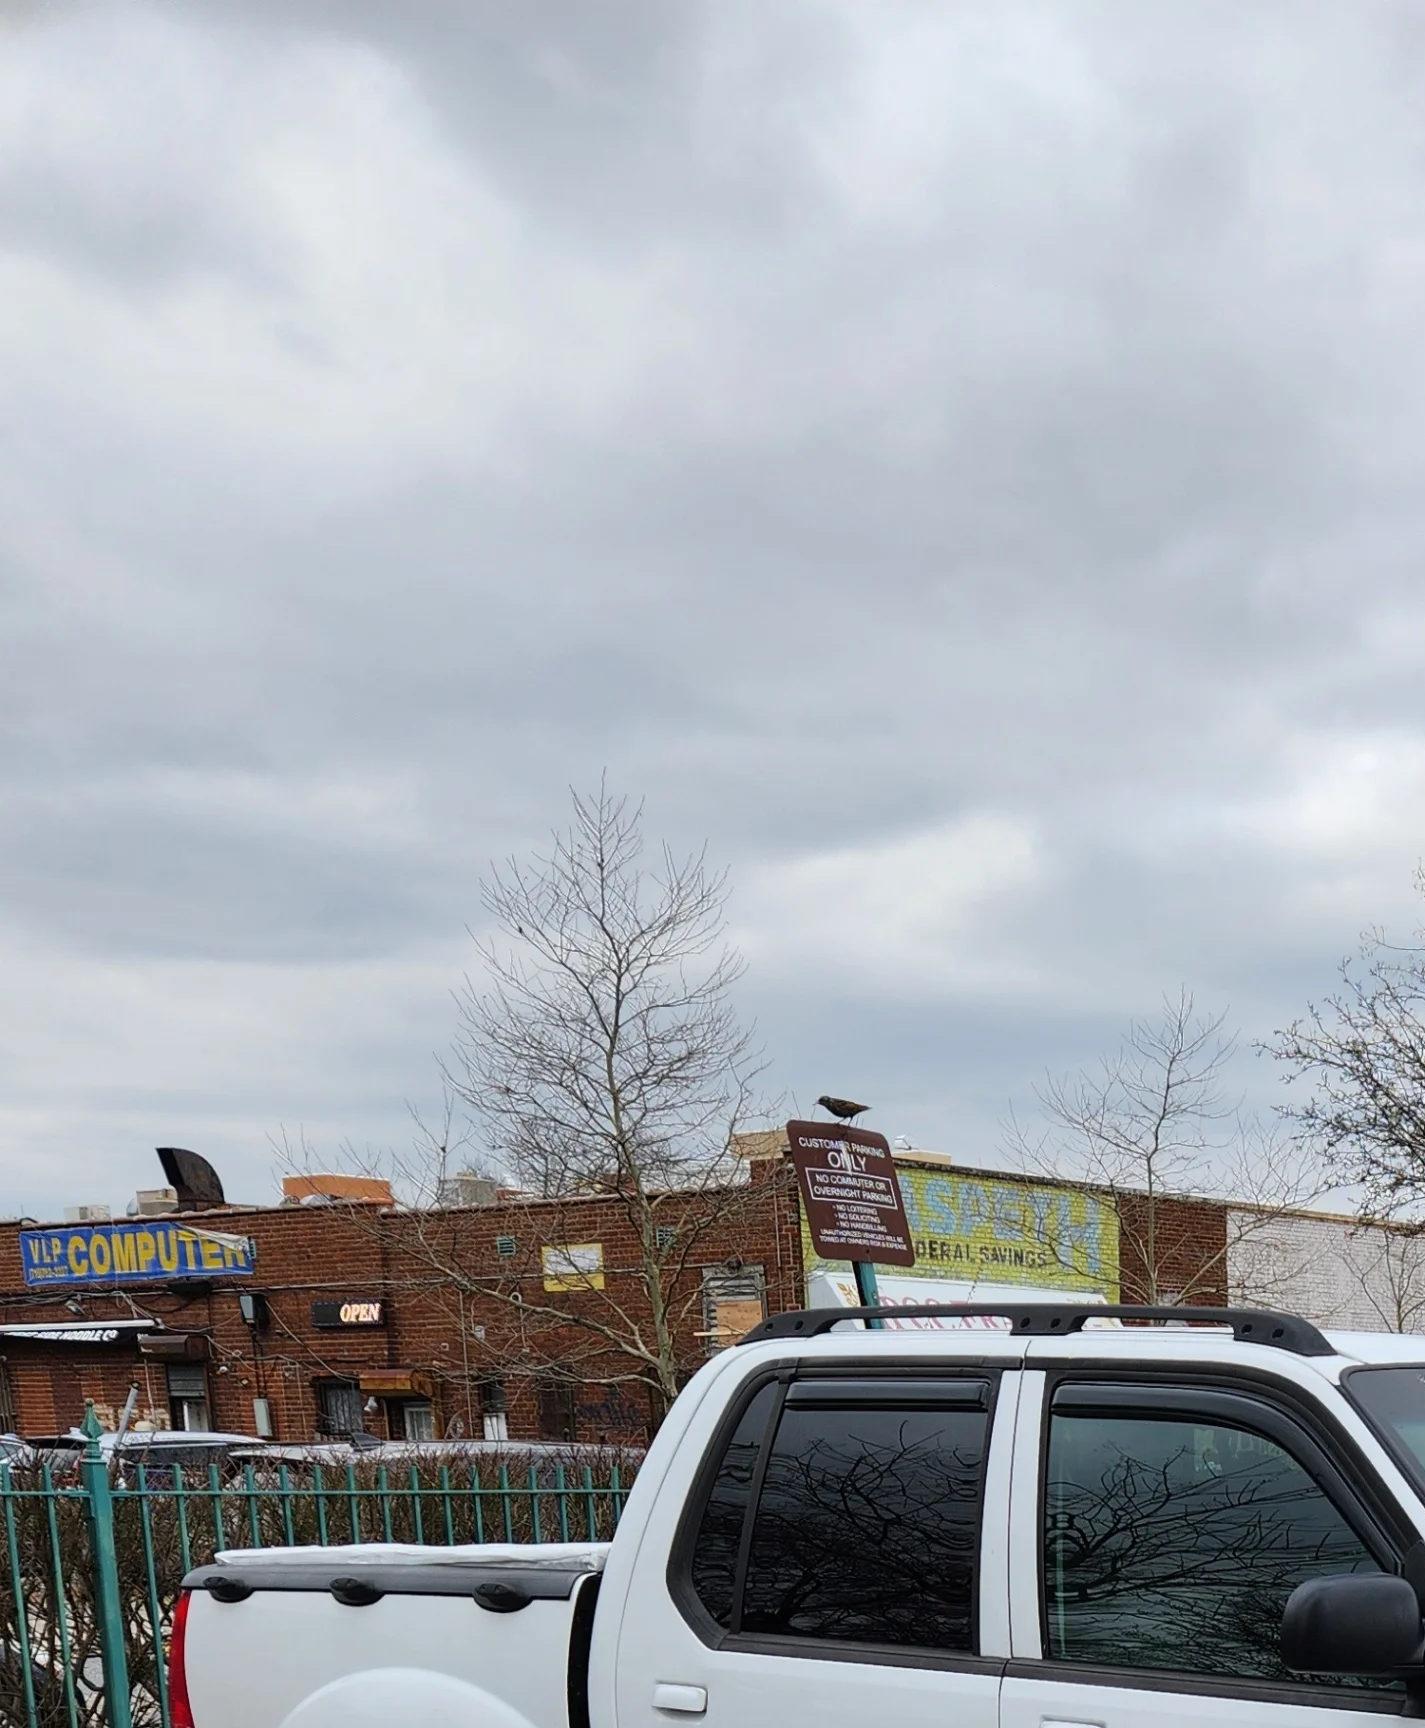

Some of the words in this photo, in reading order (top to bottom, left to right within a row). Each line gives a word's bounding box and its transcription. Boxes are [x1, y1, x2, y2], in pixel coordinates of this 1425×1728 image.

[851, 1143, 885, 1158] PARKING
[827, 1151, 866, 1172] ONLY
[815, 1174, 829, 1184] NO
[830, 1175, 874, 1190] COMMUTER
[875, 1181, 887, 1192] OR
[813, 1185, 861, 1199] OVERNIGHT
[862, 1190, 893, 1204] PARKING
[836, 1204, 847, 1212] NO
[847, 1205, 878, 1216] LOITERING
[838, 1212, 848, 1220] NO
[840, 1221, 850, 1229] NO
[899, 1174, 1101, 1274] ASPETH
[915, 1240, 976, 1264] DERAL
[979, 1246, 1048, 1269] SAVINGS
[339, 1303, 381, 1323] OPEN
[59, 1330, 102, 1341] NOODLE
